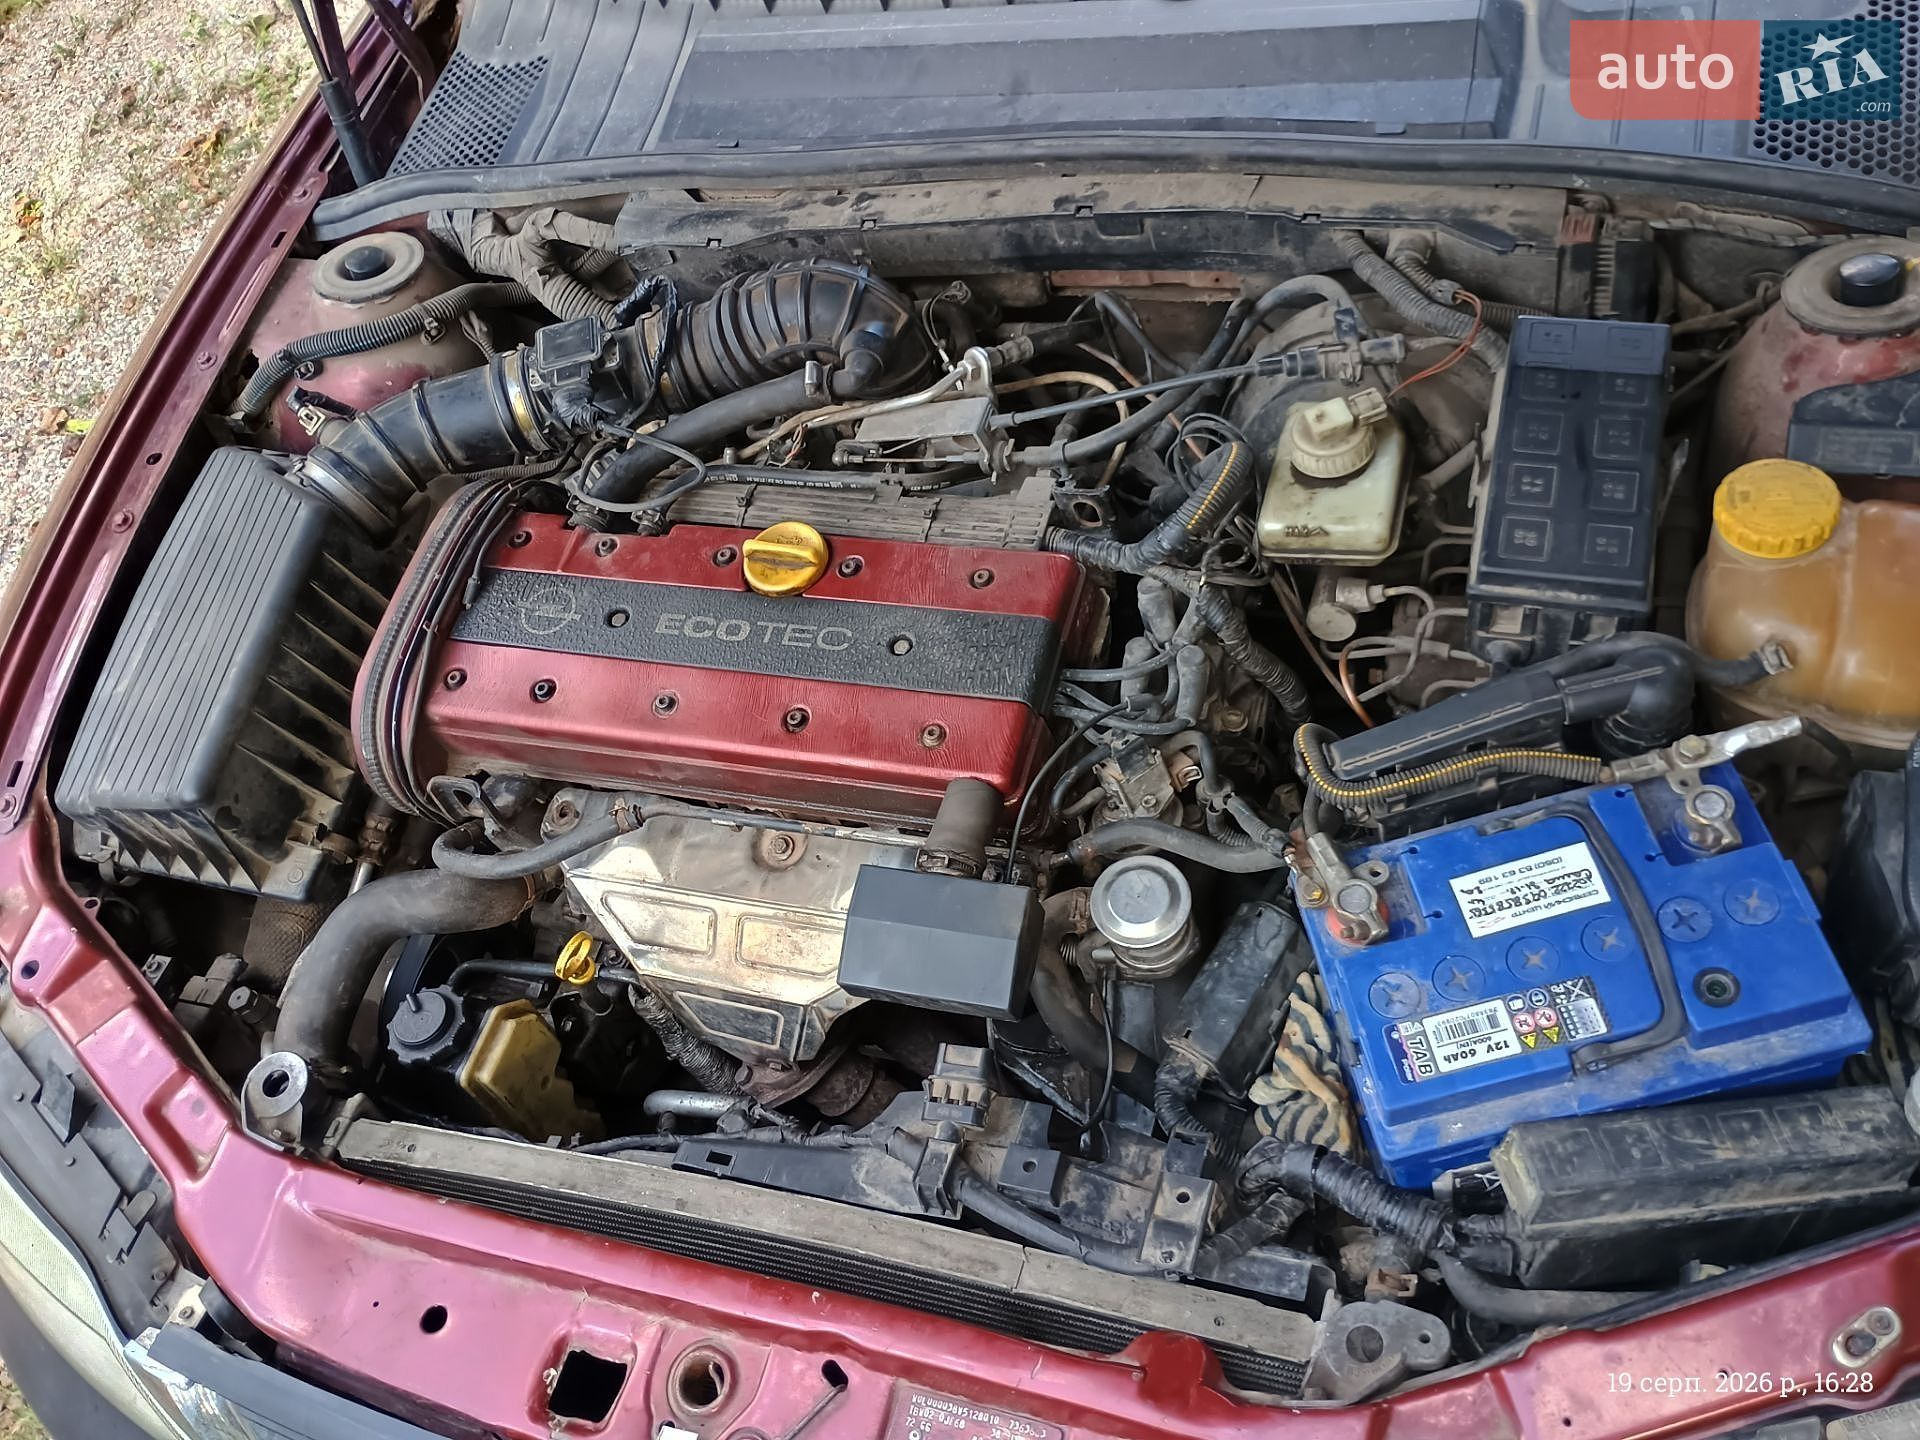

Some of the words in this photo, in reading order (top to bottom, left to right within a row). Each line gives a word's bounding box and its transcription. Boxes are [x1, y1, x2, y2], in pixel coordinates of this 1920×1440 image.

[1486, 1040, 1511, 1054] 12V
[1409, 1036, 1434, 1076] TAB
[1443, 1048, 1477, 1064] 60Ah
